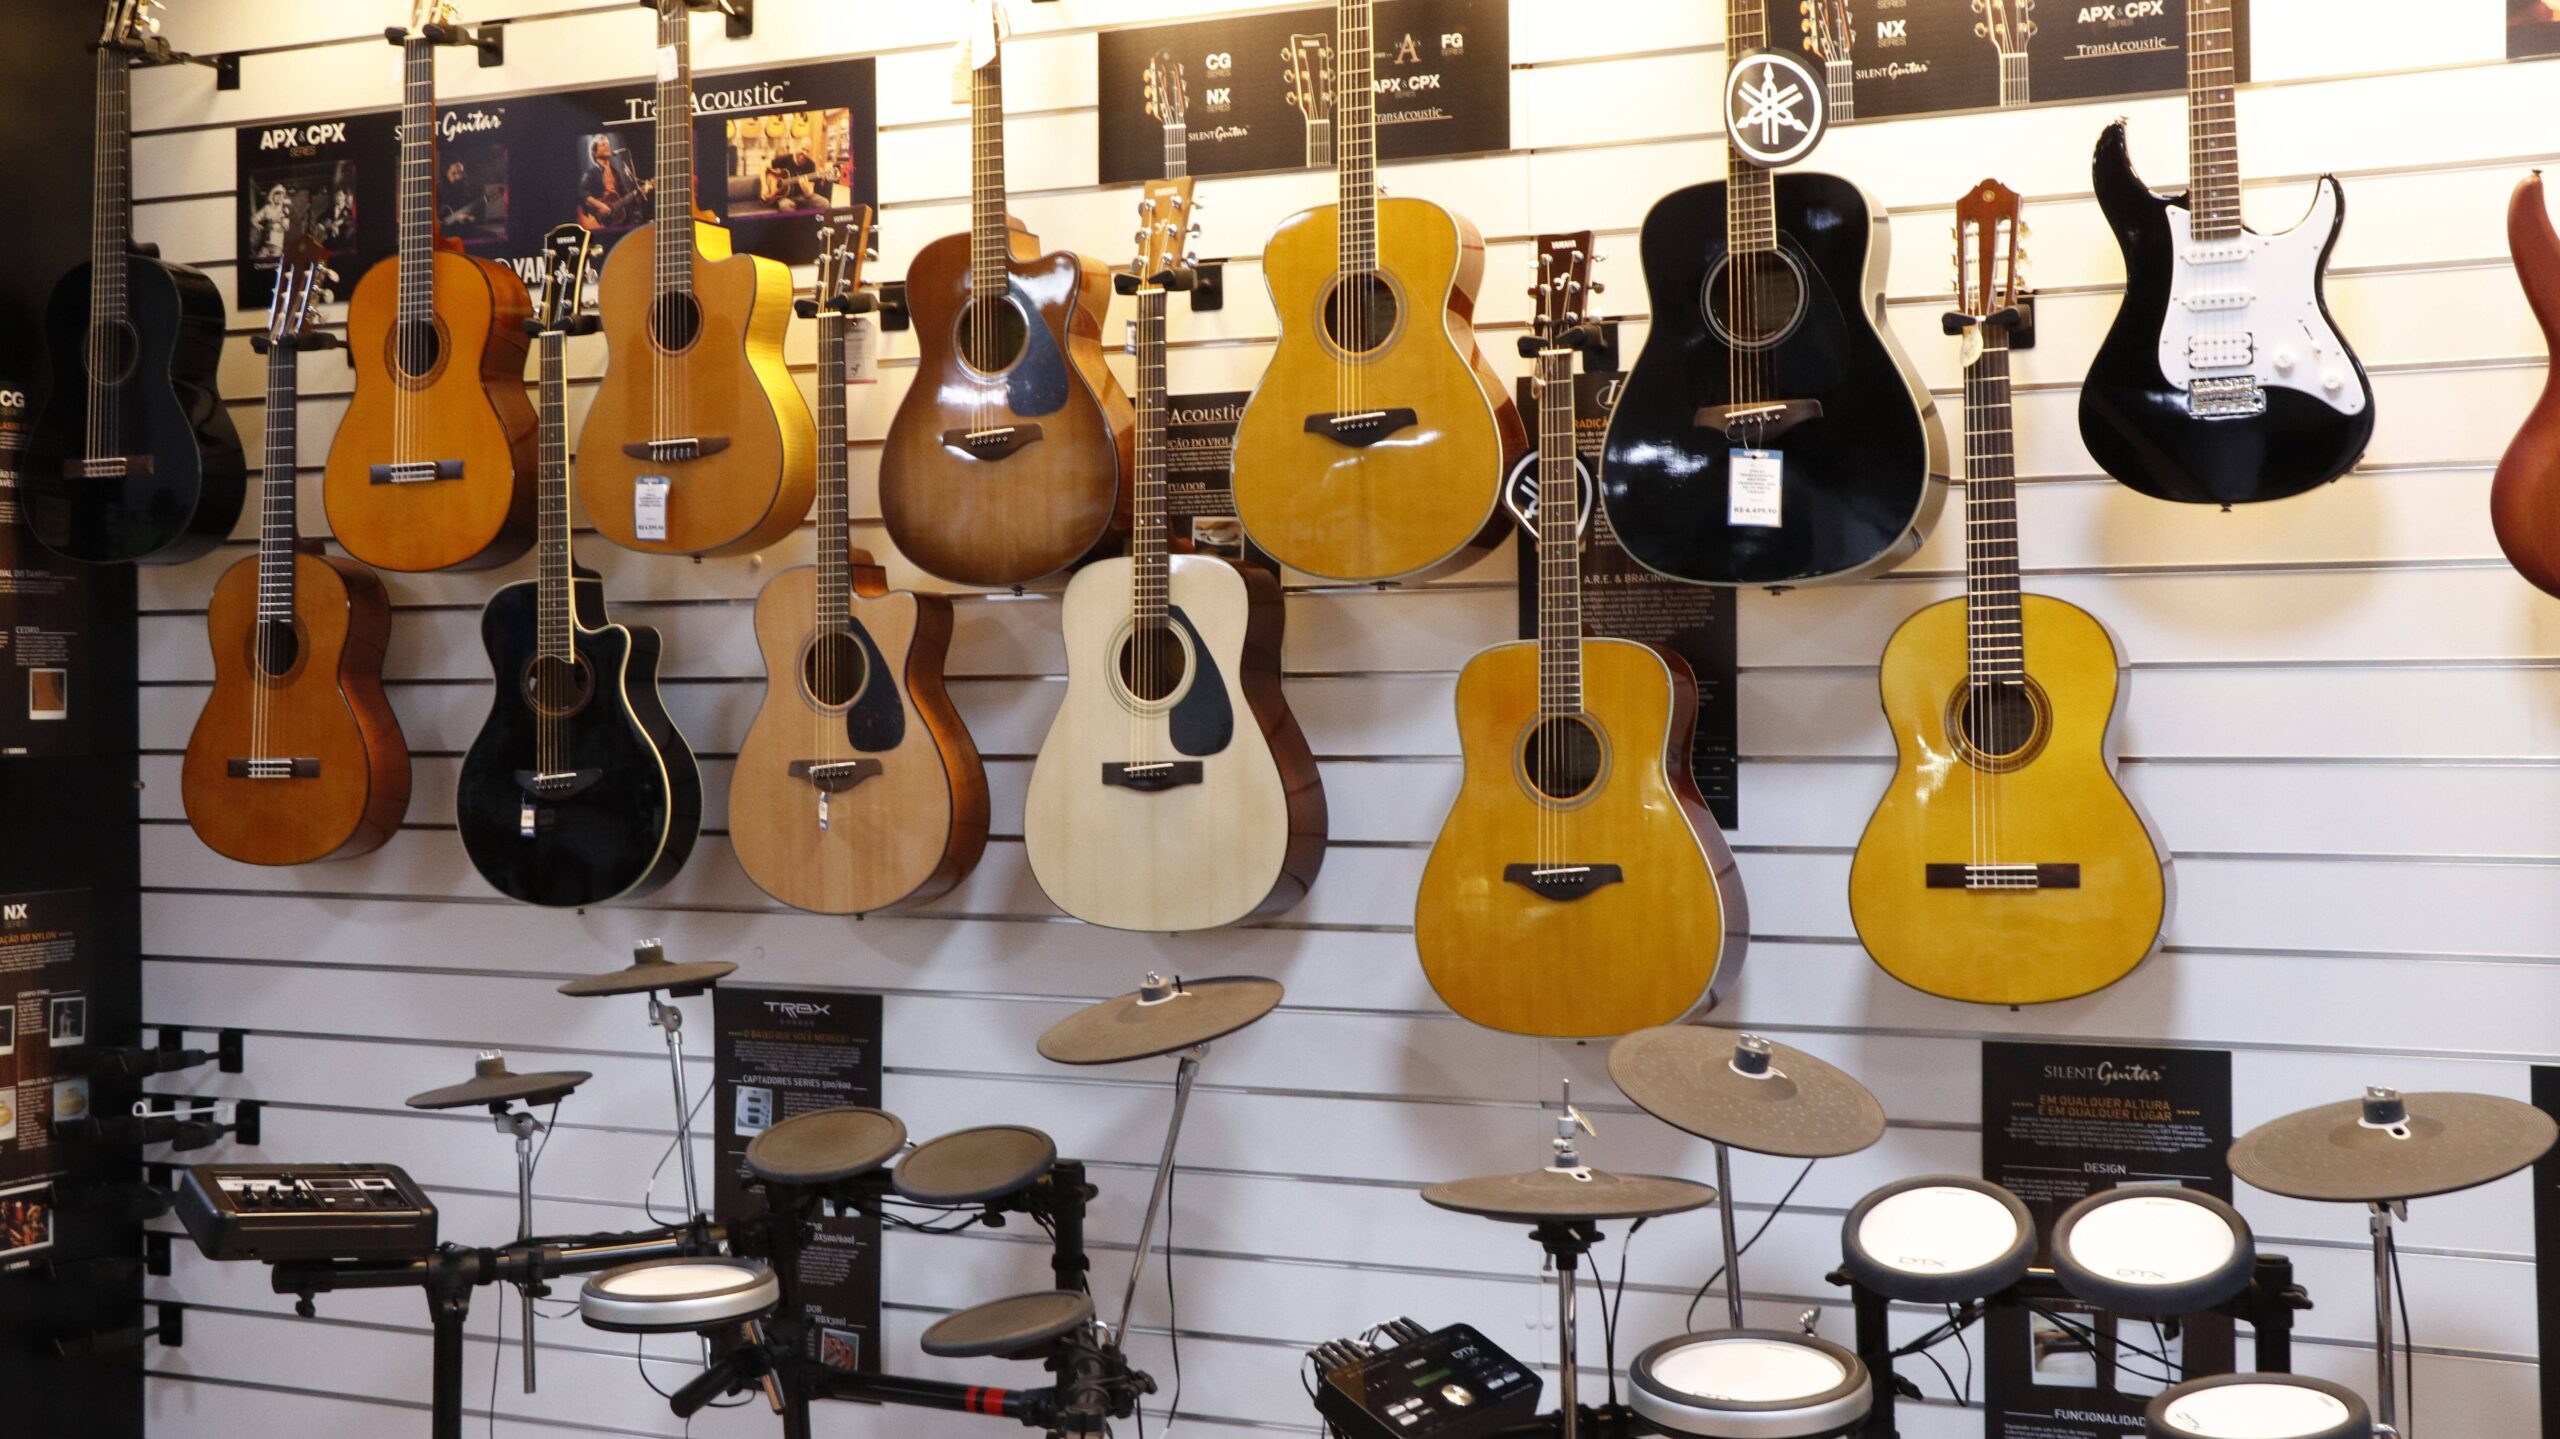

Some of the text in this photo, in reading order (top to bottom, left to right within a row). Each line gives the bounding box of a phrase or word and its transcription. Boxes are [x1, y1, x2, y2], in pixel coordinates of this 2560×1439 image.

[2078, 5, 2116, 24] APX
[2125, 0, 2164, 19] CPX
[1877, 20, 1907, 39] NX
[1441, 33, 1463, 49] FG
[2076, 37, 2167, 57] TransAcoustic
[1206, 52, 1232, 70] CG
[1409, 74, 1440, 91] CPX
[626, 83, 784, 122] TraAcoustic
[1207, 88, 1231, 105] NX
[1375, 106, 1443, 123] ransAcoustic
[260, 127, 299, 151] APX
[306, 123, 346, 147] CPX
[4, 904, 28, 920] NX
[763, 1001, 831, 1019] TRBX
[742, 1074, 792, 1086] CAPTADORES
[2044, 1061, 2162, 1086] SILENT Guitar
[2040, 1094, 2170, 1111] EM QUALQUER ALTURA
[2037, 1103, 2172, 1122] E EM QUALQUER LUGAR
[2083, 1162, 2127, 1175] DESIGN
